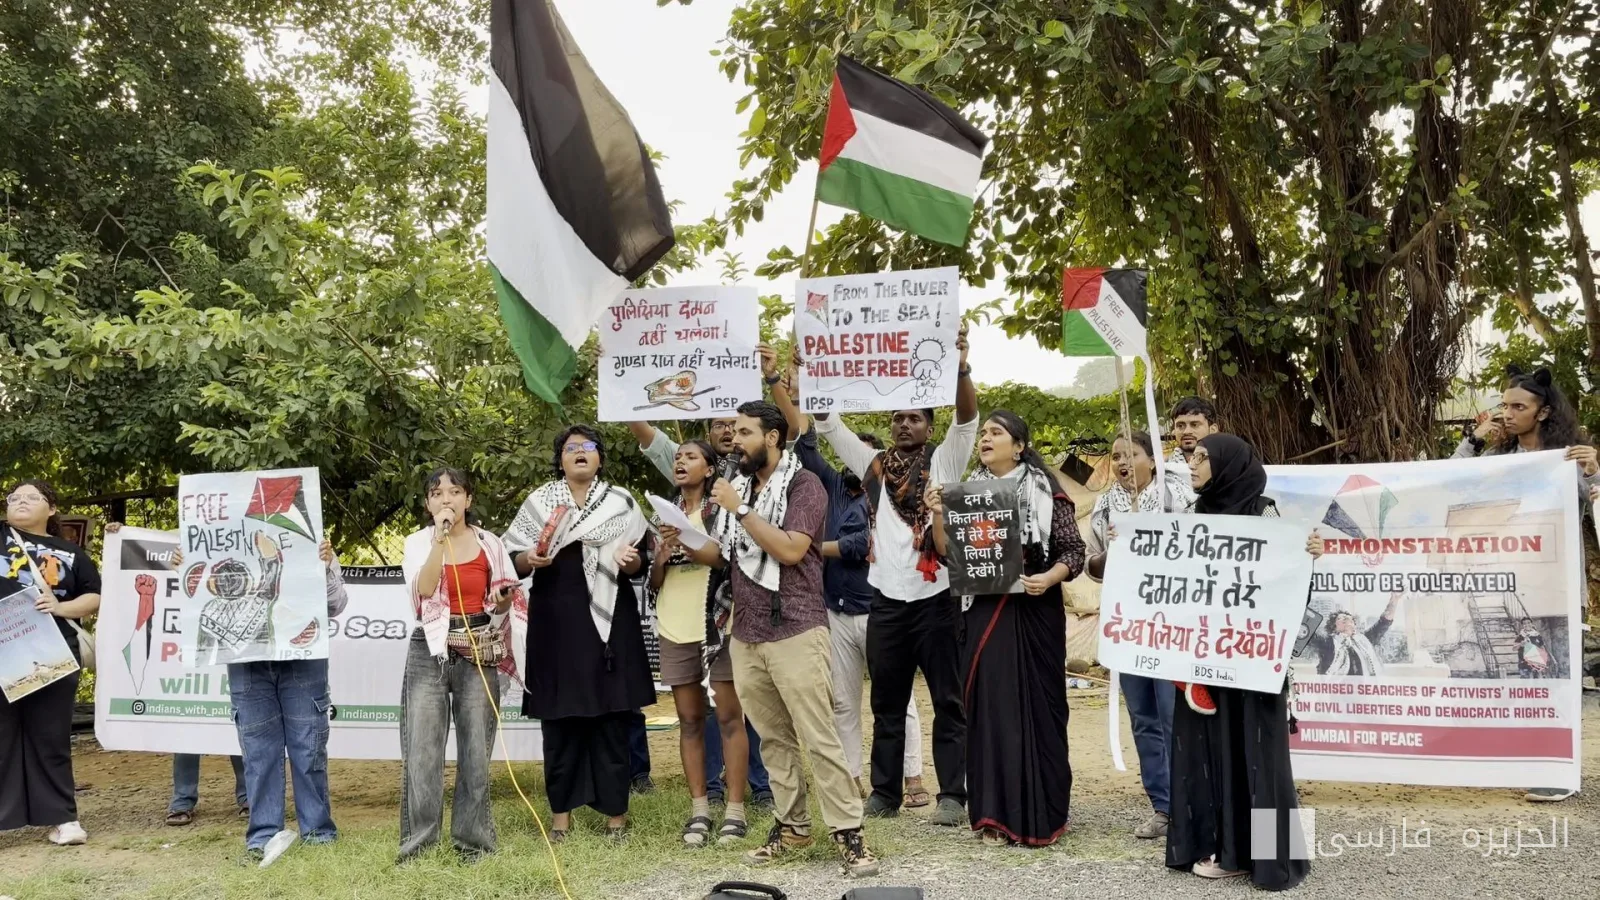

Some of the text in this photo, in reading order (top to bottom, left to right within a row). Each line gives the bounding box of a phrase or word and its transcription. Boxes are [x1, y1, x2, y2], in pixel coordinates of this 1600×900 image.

[833, 279, 949, 302] FROM THE RIVER
[679, 300, 717, 319] दमन
[1104, 294, 1125, 318] FREE
[832, 308, 853, 326] TO
[860, 306, 890, 324] THE
[639, 323, 667, 346] नहीं
[1088, 308, 1125, 350] PALESTINE
[804, 331, 910, 356] PALESTINE
[651, 354, 676, 368] राज
[678, 347, 705, 369] नहीं
[805, 360, 840, 378] WILL
[843, 359, 865, 377] BE
[711, 398, 739, 408] IPSP
[805, 397, 834, 410] IPSP
[964, 489, 994, 506] दम है
[182, 493, 229, 525] FREE
[948, 509, 1013, 526] कितना दमन
[956, 526, 1008, 542] में तेरे देख
[1130, 520, 1268, 562] दम है कितना
[964, 543, 1003, 561] लिया है
[1323, 535, 1542, 554] EMONSTRATION
[145, 550, 174, 563] Indi
[367, 568, 403, 578] Pales
[1138, 564, 1262, 609] दमन में तेरे
[1312, 572, 1516, 592] ILL NOT BE TOLERATED!
[344, 615, 406, 640] Sea
[1147, 611, 1194, 652] लिया
[1194, 615, 1210, 660] है
[279, 650, 312, 660] IPSP
[1135, 655, 1161, 671] IPSP
[1194, 665, 1234, 682] BDS India
[159, 673, 209, 695] will
[1357, 684, 1417, 697] SEARCHES
[1421, 686, 1436, 697] OF
[1509, 687, 1549, 699] HOMES
[1296, 702, 1311, 713] ON
[1314, 702, 1342, 714] CIVIL
[1346, 703, 1403, 716] LIBERTIES
[1407, 705, 1431, 717] AND
[1435, 706, 1510, 719] DEMOCRATIC
[1514, 707, 1560, 719] RIGHTS.
[1300, 728, 1423, 747] MUMBAI FOR PEACE
